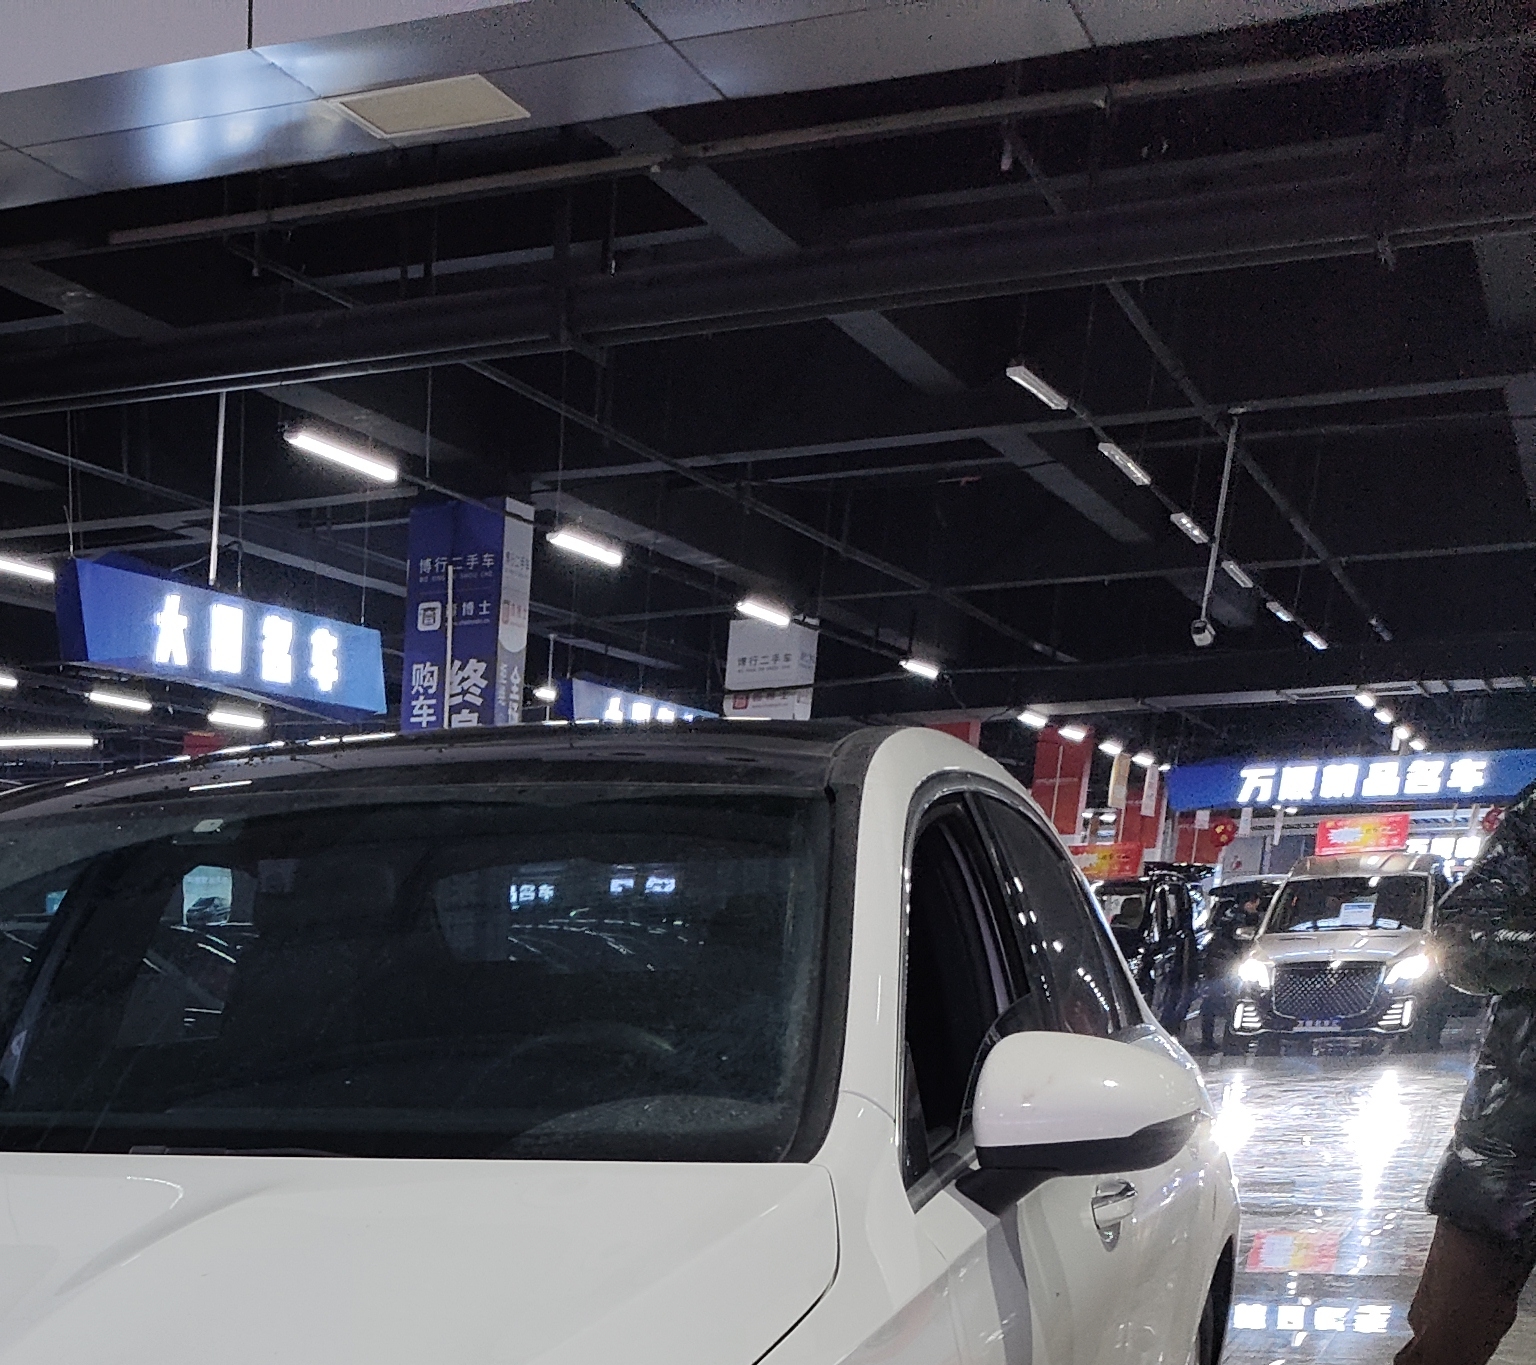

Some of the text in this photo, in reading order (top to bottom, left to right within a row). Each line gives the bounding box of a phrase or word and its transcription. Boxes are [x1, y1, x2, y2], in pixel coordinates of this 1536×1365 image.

[419, 553, 495, 574] 博行二手车
[410, 661, 439, 729] 购车
